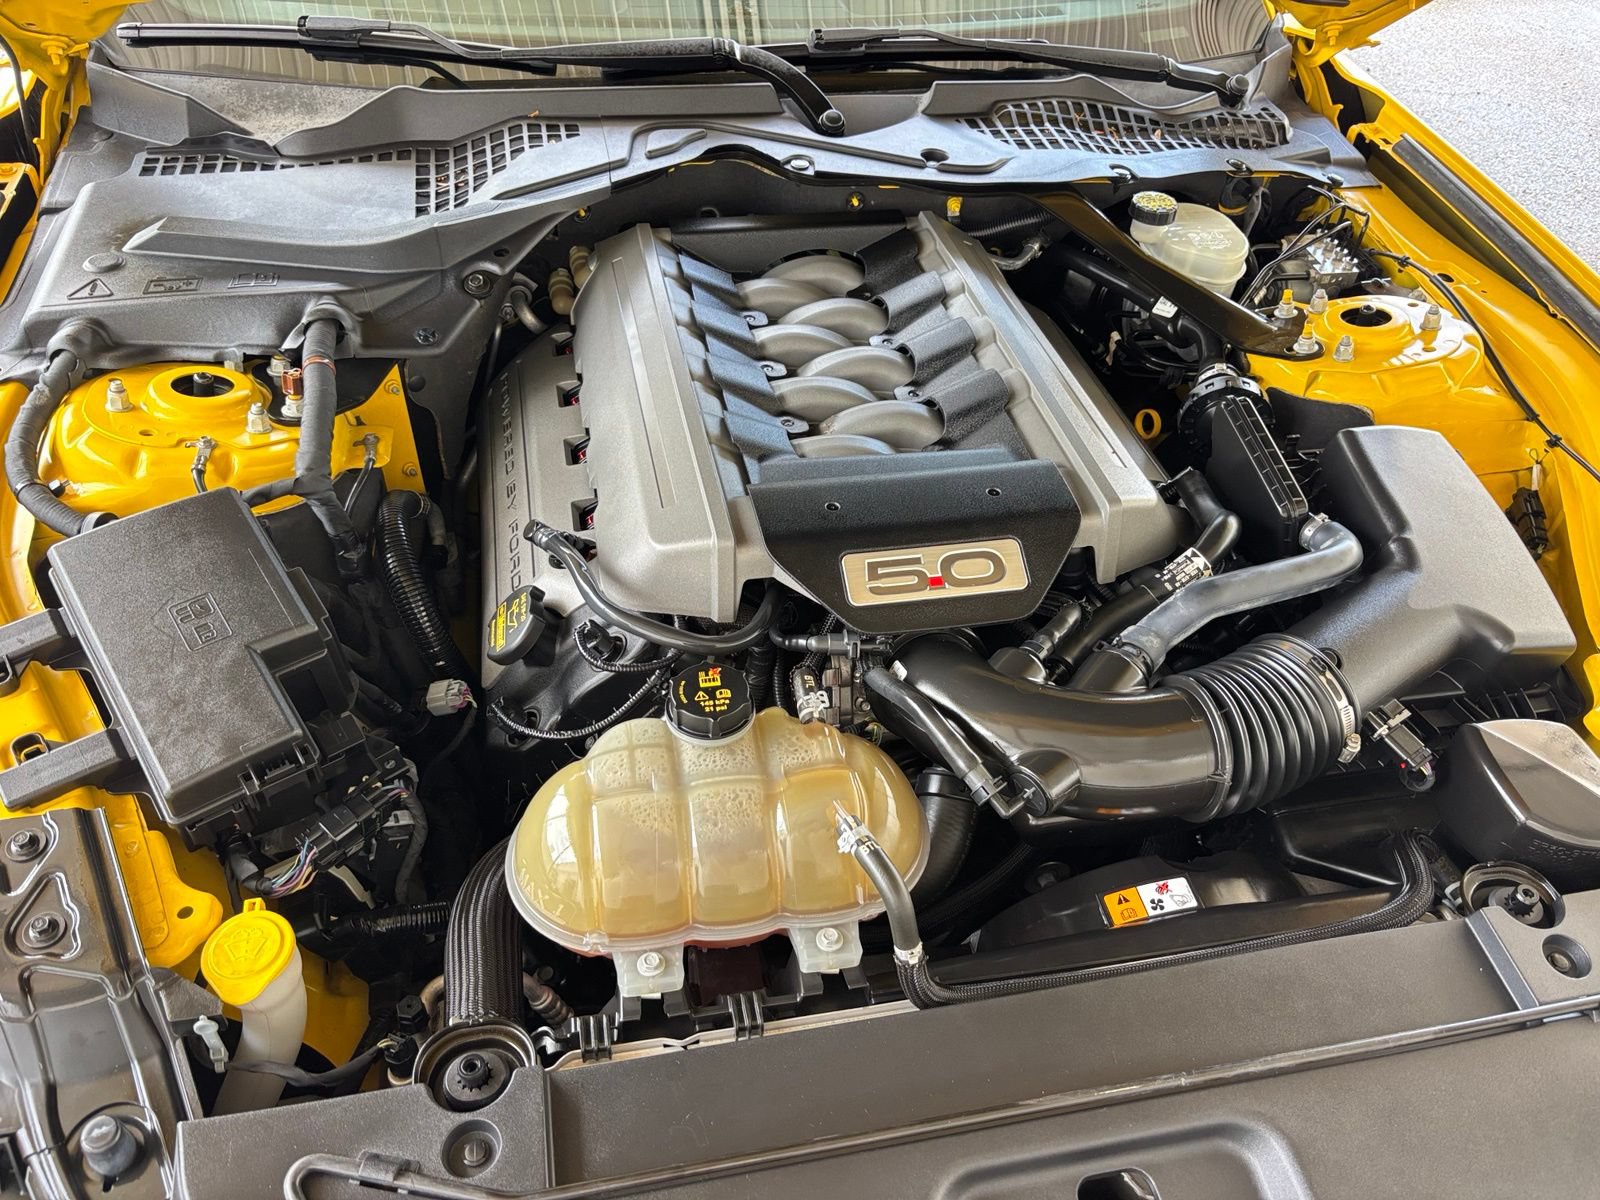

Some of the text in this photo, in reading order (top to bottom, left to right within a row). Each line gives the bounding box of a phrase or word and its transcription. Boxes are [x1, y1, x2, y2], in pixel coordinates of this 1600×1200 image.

[500, 372, 521, 591] POWERED BY FORD
[865, 548, 1007, 596] 5.0
[715, 704, 728, 712] psi
